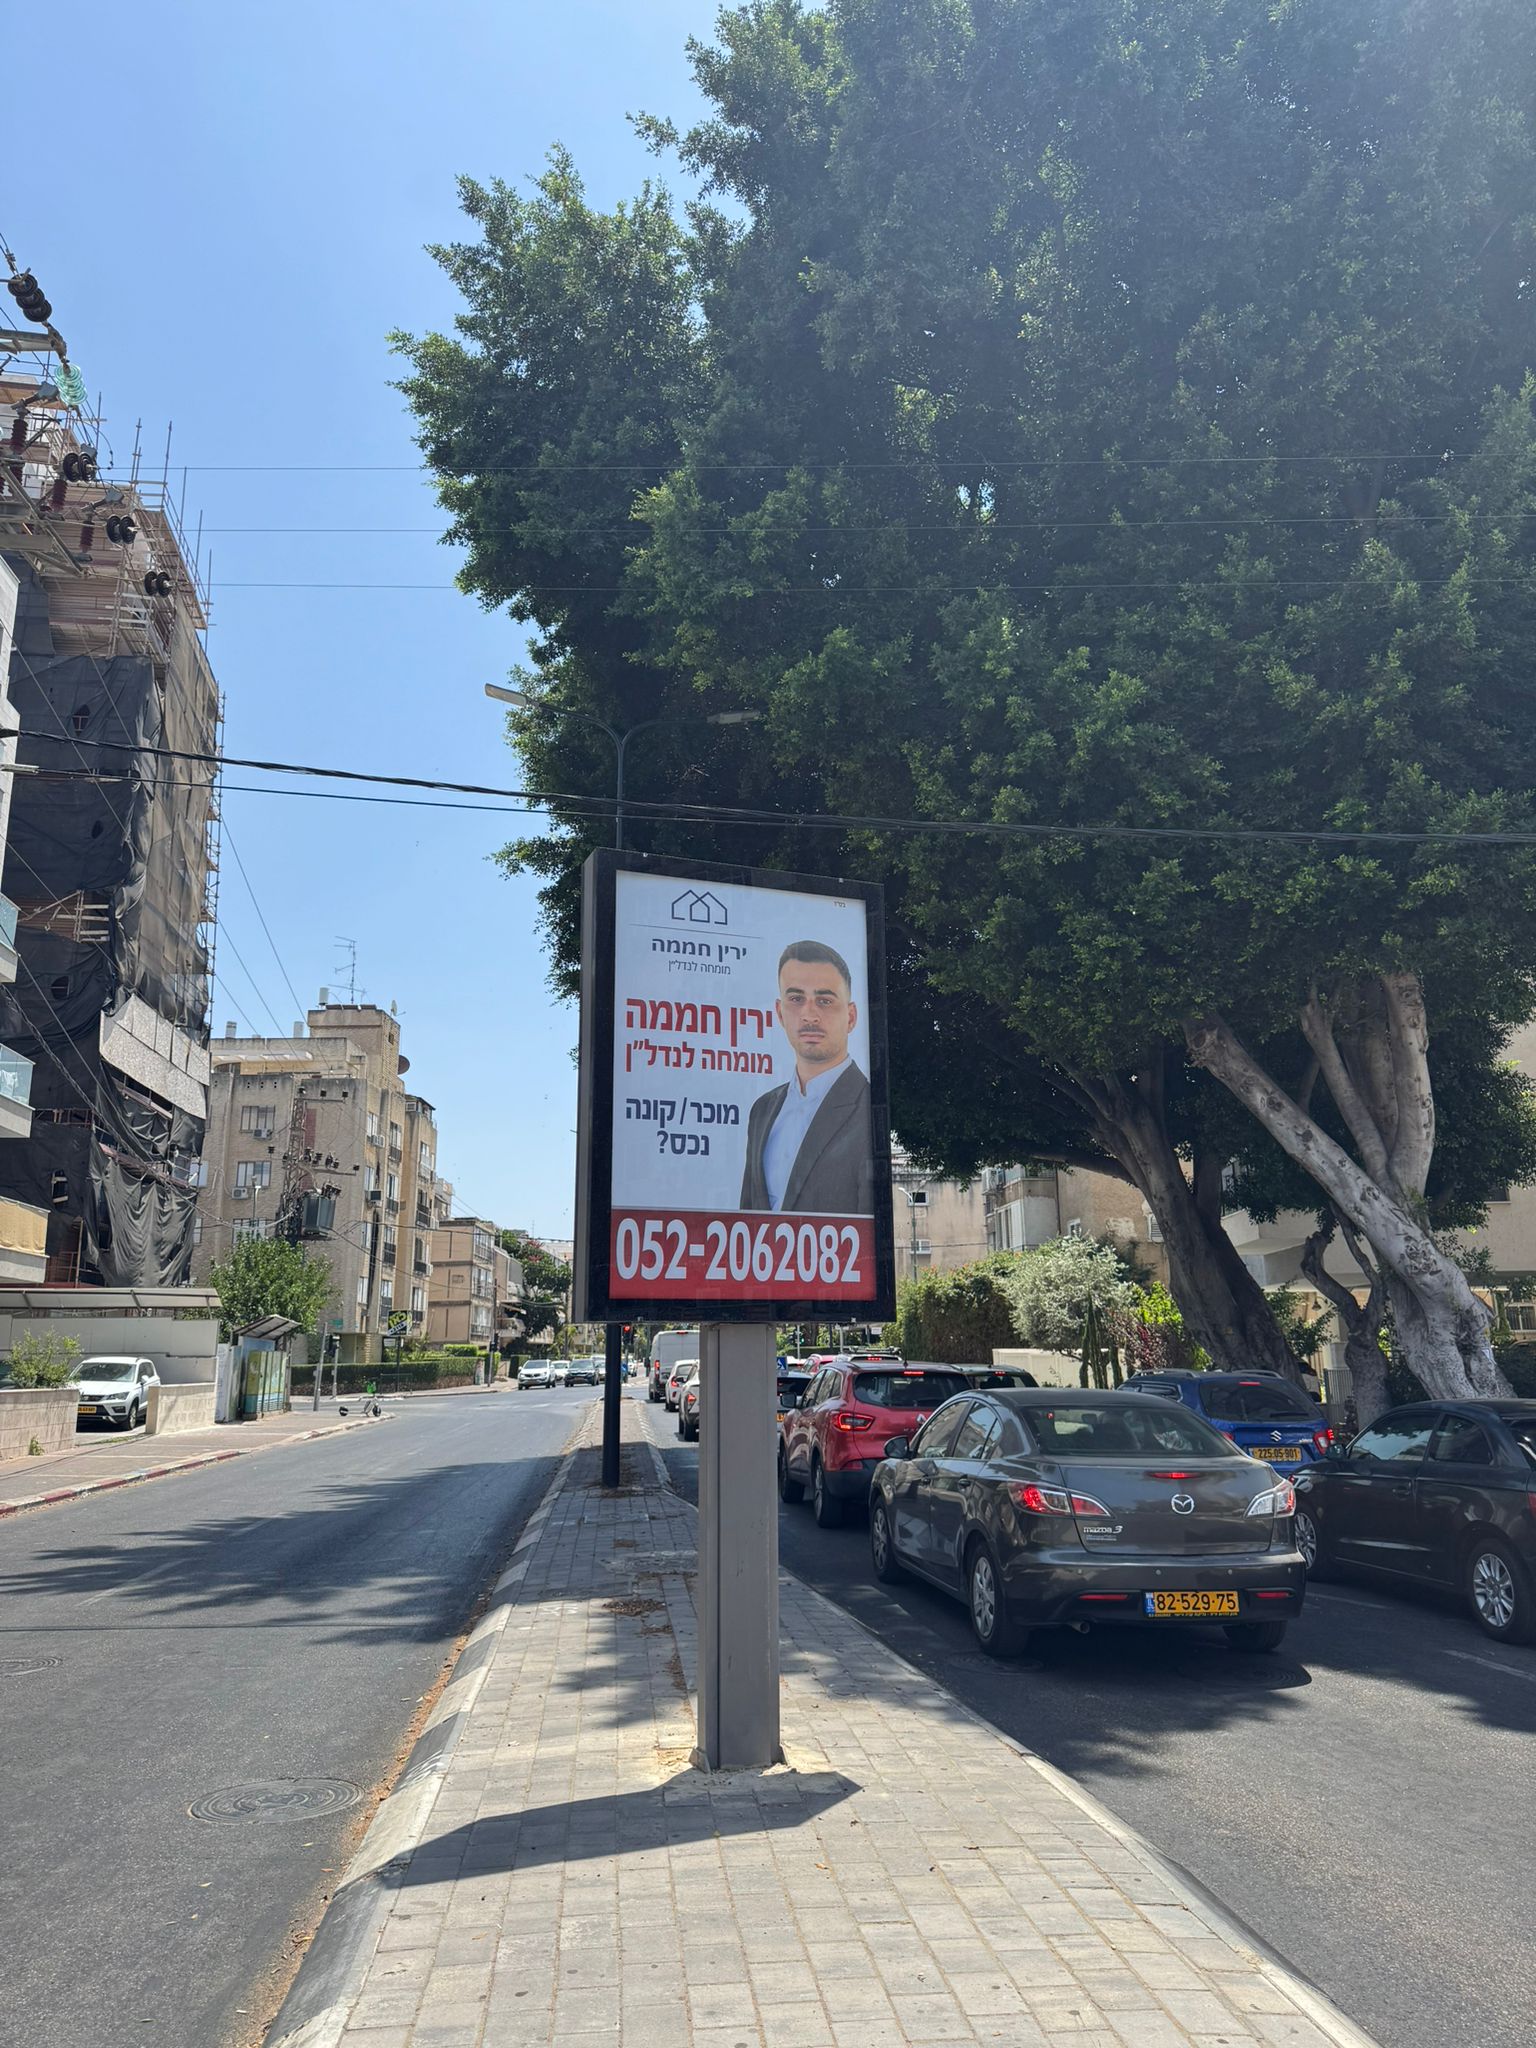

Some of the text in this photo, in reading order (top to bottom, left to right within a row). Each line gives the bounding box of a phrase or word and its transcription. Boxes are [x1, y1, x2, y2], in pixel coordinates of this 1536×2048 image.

[652, 938, 747, 962] ירין חממה
[700, 963, 731, 975] מומחה
[626, 998, 773, 1047] ירין חממה
[626, 1038, 773, 1075] מומחה לנדל"ן
[657, 1130, 710, 1156] נכס?
[616, 1218, 861, 1283] 052-2062082
[1112, 1525, 1123, 1534] 3
